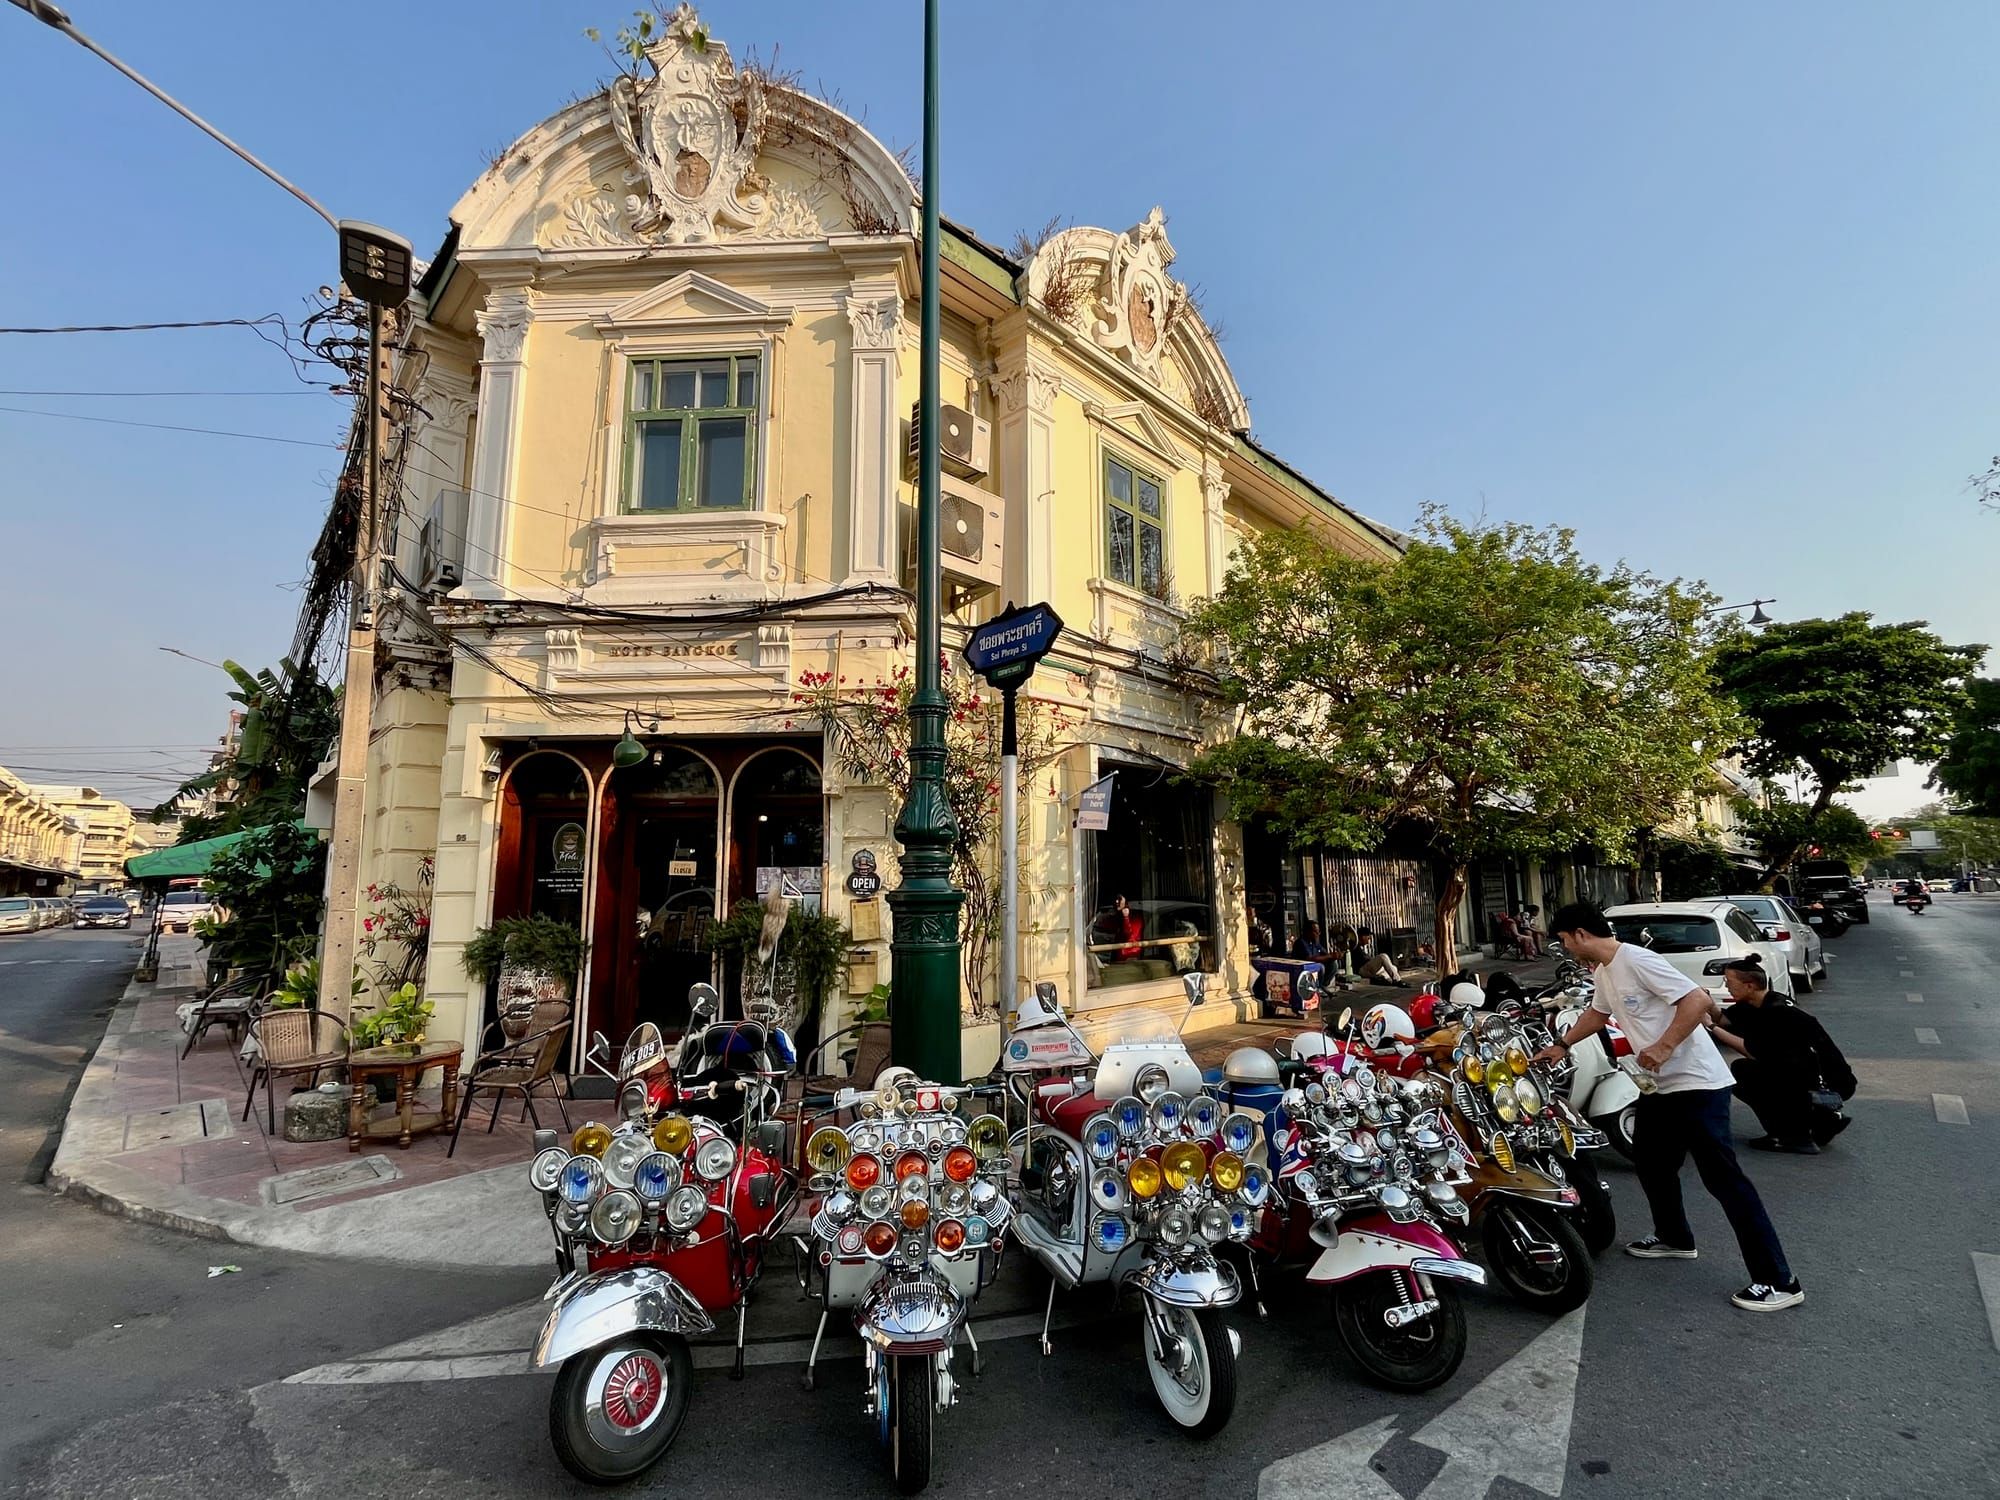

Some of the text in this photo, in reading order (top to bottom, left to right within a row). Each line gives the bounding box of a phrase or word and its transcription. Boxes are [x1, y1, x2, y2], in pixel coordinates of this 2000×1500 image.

[979, 612, 1043, 652] ซอยพระยาศรี
[662, 645, 738, 657] BANGKOK
[991, 643, 1028, 661] Soi Phraya Si
[852, 877, 876, 889] OPEN
